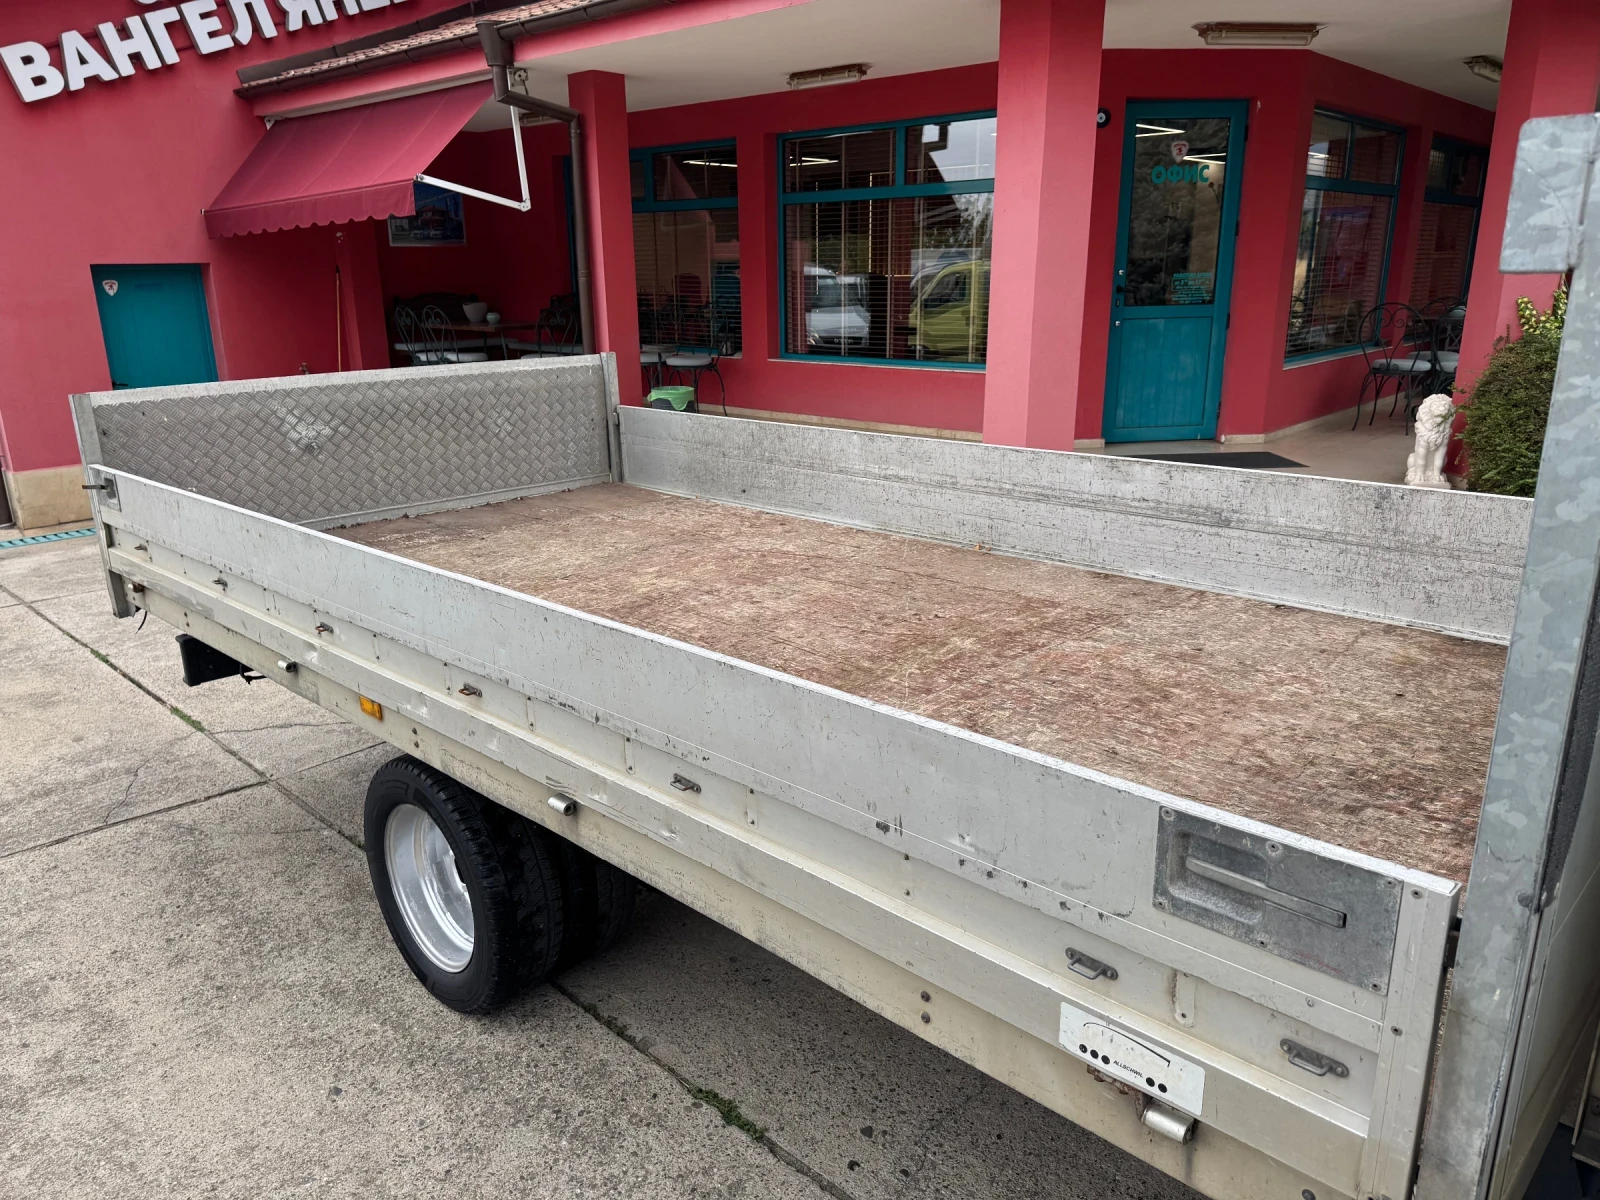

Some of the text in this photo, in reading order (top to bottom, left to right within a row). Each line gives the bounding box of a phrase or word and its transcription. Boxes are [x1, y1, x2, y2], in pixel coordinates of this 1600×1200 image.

[0, 0, 278, 103] ВАНГЕЛ
[1151, 164, 1210, 185] ОФИС
[1113, 1060, 1143, 1078] ALLSCHWIL
